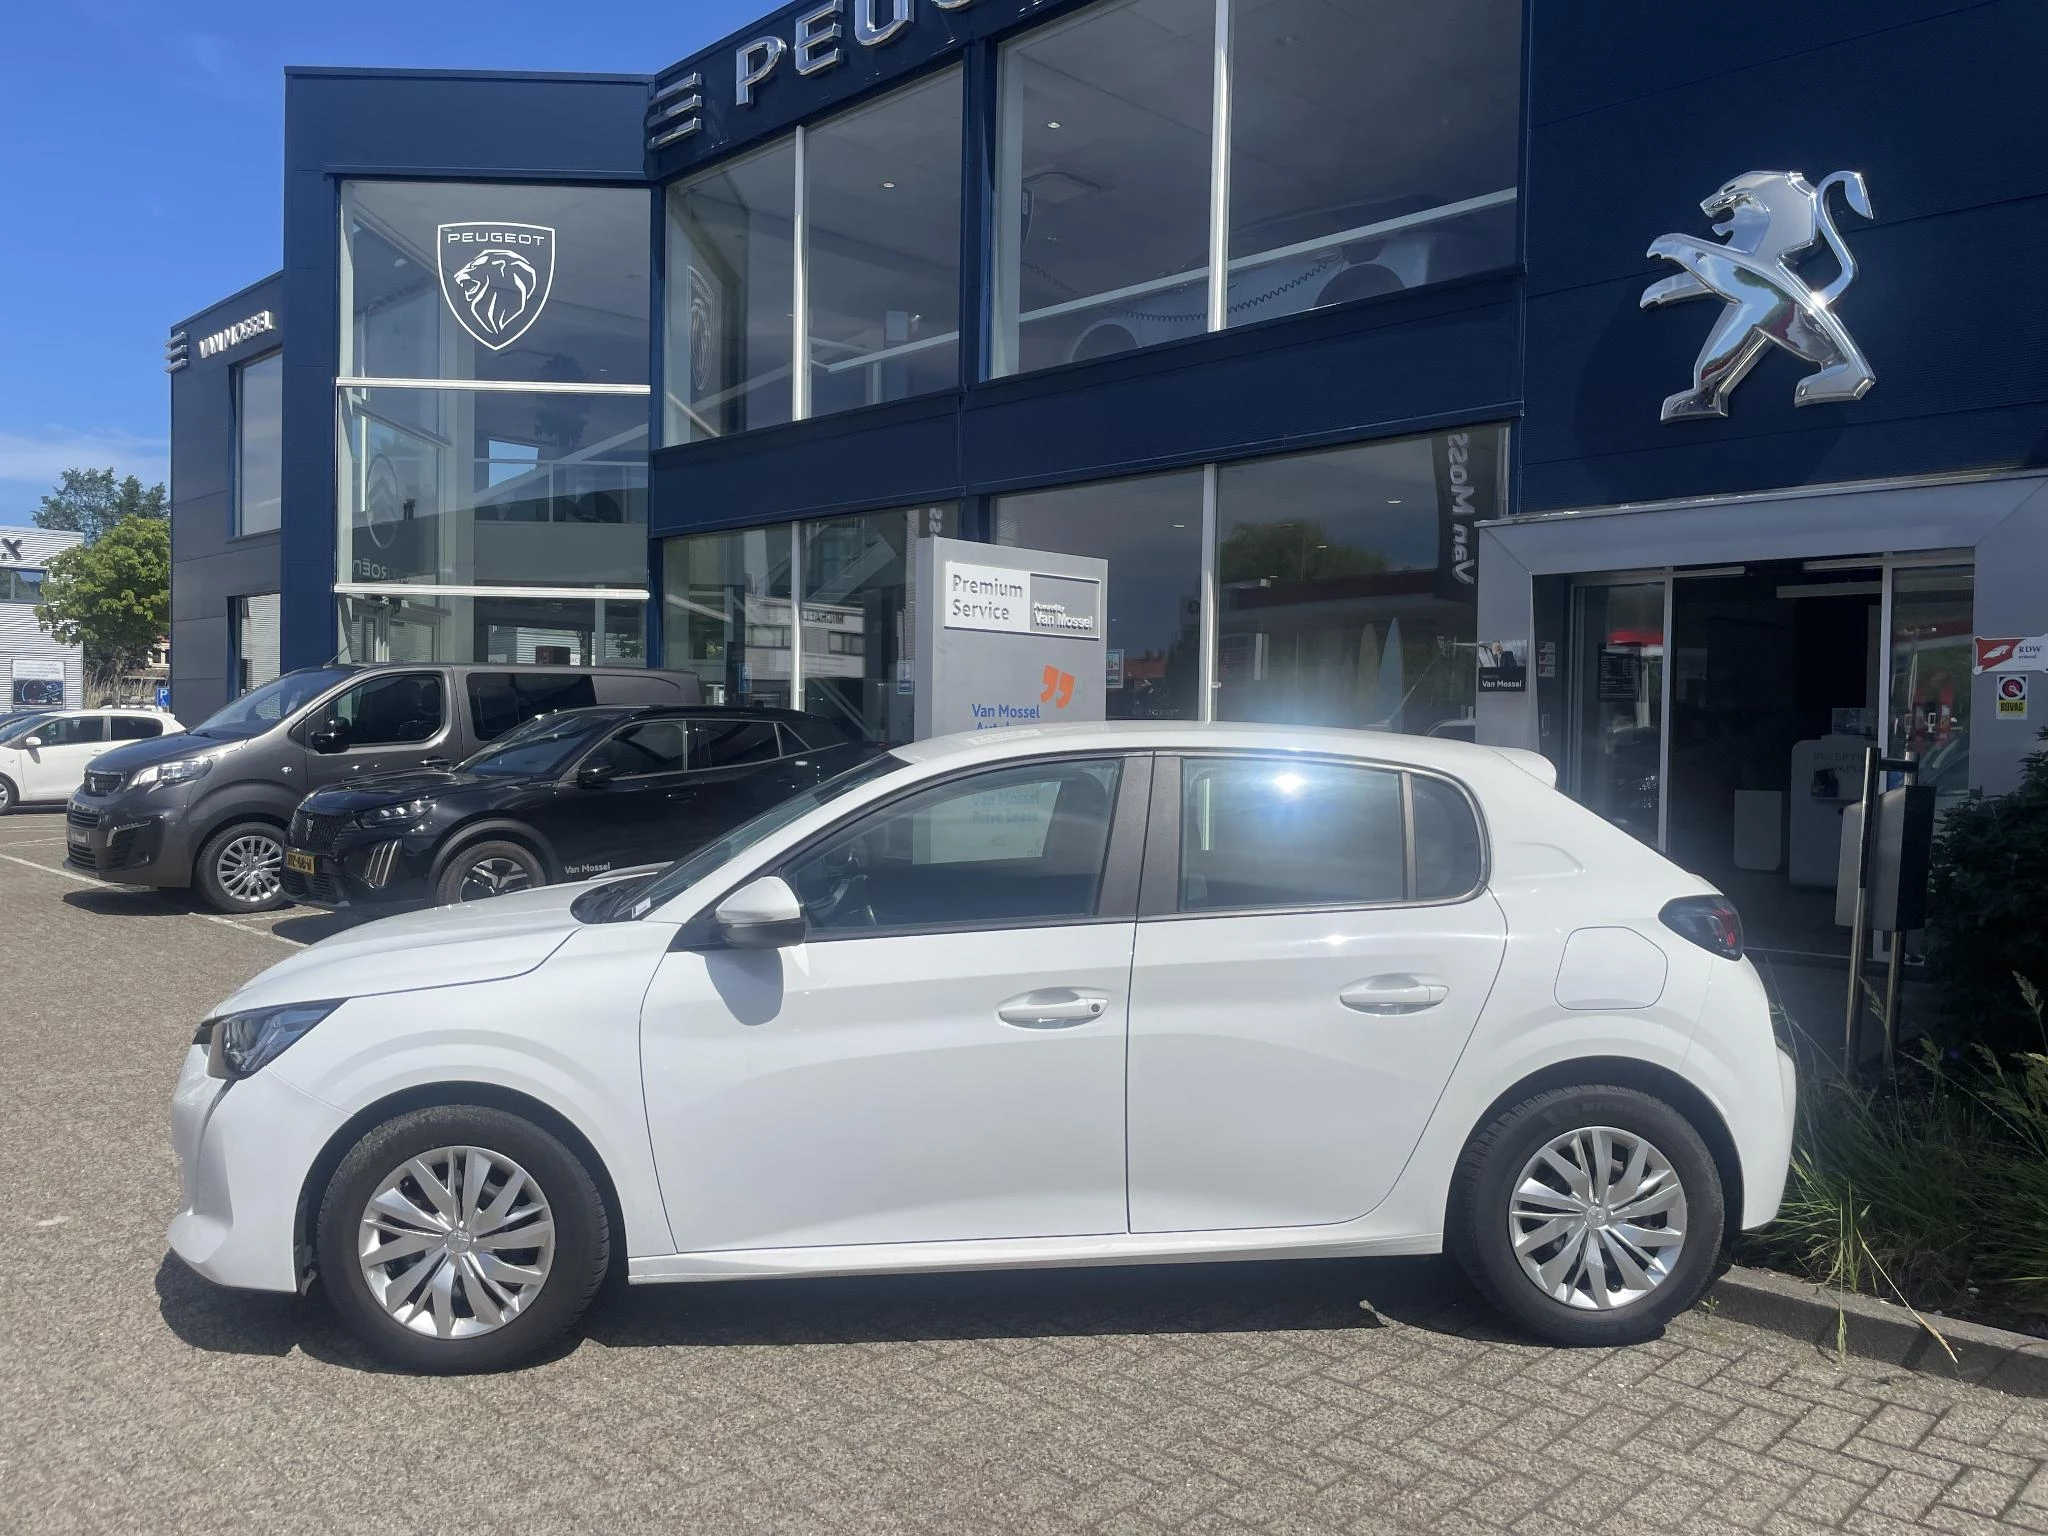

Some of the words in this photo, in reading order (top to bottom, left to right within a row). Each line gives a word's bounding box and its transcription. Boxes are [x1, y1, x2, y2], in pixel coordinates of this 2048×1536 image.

[735, 0, 974, 106] PEU
[447, 232, 545, 246] PEUGEOT
[224, 311, 274, 349] MOSSEL
[952, 574, 1024, 599] Premium
[952, 598, 1010, 621] Service
[1034, 611, 1055, 627] Van
[1057, 613, 1093, 631] Mossel
[2019, 645, 2041, 653] RDW
[1481, 680, 1496, 688] Van
[1497, 679, 1522, 688] Mossel
[972, 703, 995, 718] Van
[998, 704, 1041, 719] Mossel
[2000, 702, 2024, 712] BOVAG
[564, 864, 580, 874] Van
[581, 861, 611, 873] Mossel
